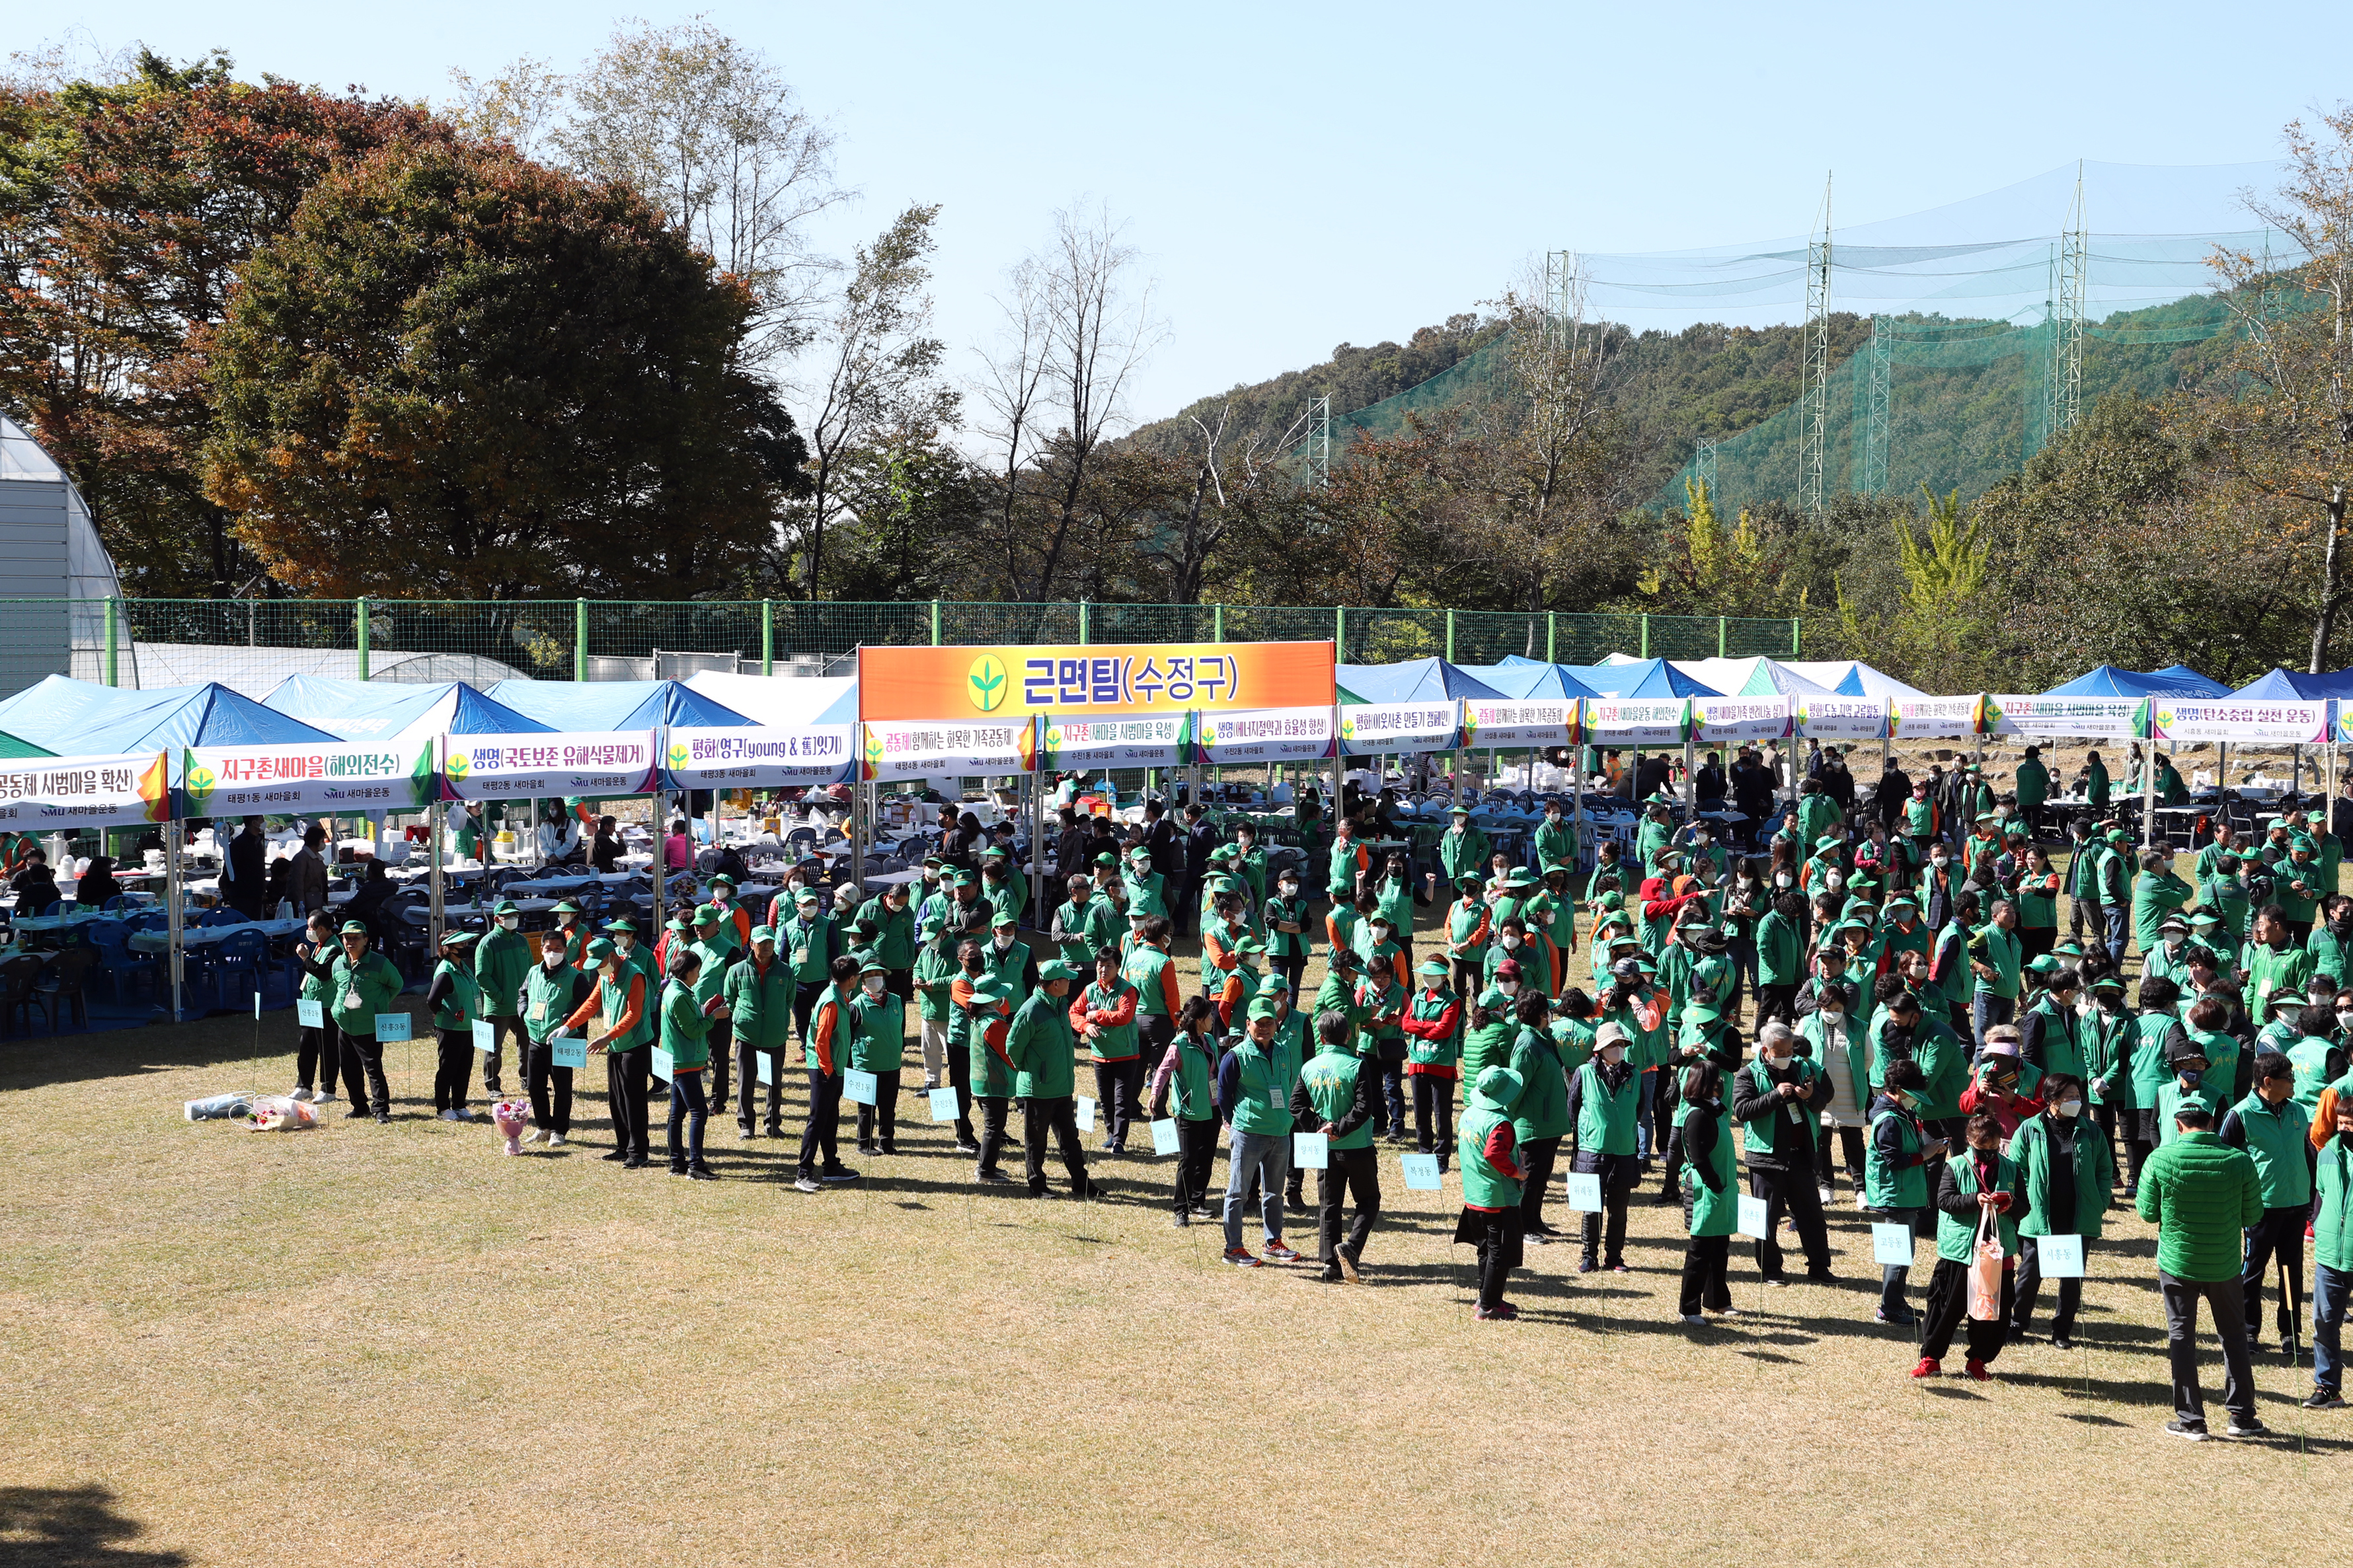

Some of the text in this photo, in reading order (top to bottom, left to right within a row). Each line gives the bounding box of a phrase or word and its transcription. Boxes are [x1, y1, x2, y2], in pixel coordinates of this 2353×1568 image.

[1024, 655, 1237, 704] 근면팀(수정구)
[1519, 708, 1535, 723] 화목한
[1600, 706, 1679, 722] 지구촌(새마을운동 해외전수)
[2004, 702, 2130, 718] 지구촌(새마을 시범마을 육성)
[2175, 707, 2315, 724] 생명(탄소중립 실천 운동)
[1356, 710, 1451, 731] 평화(이웃사촌 만들기 캠페인)
[1063, 722, 1175, 741] 지구촌(새마을 시범마을 육성)
[1217, 718, 1327, 739] 생명(에너지절약과 효율성 향상)
[789, 737, 798, 756] &
[886, 728, 1014, 753] 공동체(함께하는 화목한 가족공동체)
[1138, 749, 1165, 758] 새마을운동
[1293, 744, 1317, 753] 새마을운동
[472, 745, 644, 769] 생명(국토보존 유해식물제거)
[985, 757, 1015, 765] 새마을운동
[1093, 751, 1114, 759] 새마을회
[221, 754, 400, 780] 지구촌새마을(해외전수)
[799, 766, 833, 776] 새마을운동
[895, 760, 946, 770] 태평4동 새마을회
[701, 768, 756, 779] 태평3동 새마을회
[41, 770, 96, 796] 시범마을
[101, 768, 134, 793] 확산)
[482, 779, 545, 791] 태평2동 새마을회
[570, 776, 627, 788] SMU 새마을운동
[227, 791, 301, 804] 태평1동 새마을회
[323, 787, 390, 800] SMU 새마을운동
[40, 803, 118, 817] SMU 새마을운동
[301, 1008, 319, 1018] 신흥2동
[380, 1023, 406, 1031] 신흥3동
[557, 1047, 582, 1057] 태평2동
[2218, 1045, 2232, 1053] SMU
[847, 1079, 871, 1092] 수진1동
[933, 1098, 954, 1109] 수진2동
[1157, 1131, 1173, 1142] 산성동
[1300, 1145, 1320, 1155] 양지동
[1410, 1166, 1432, 1177] 복정동
[1574, 1185, 1594, 1196] 위례동
[1744, 1209, 1760, 1222] 신촌동
[1880, 1237, 1902, 1249] 고등동
[2046, 1249, 2072, 1261] 시흥동
